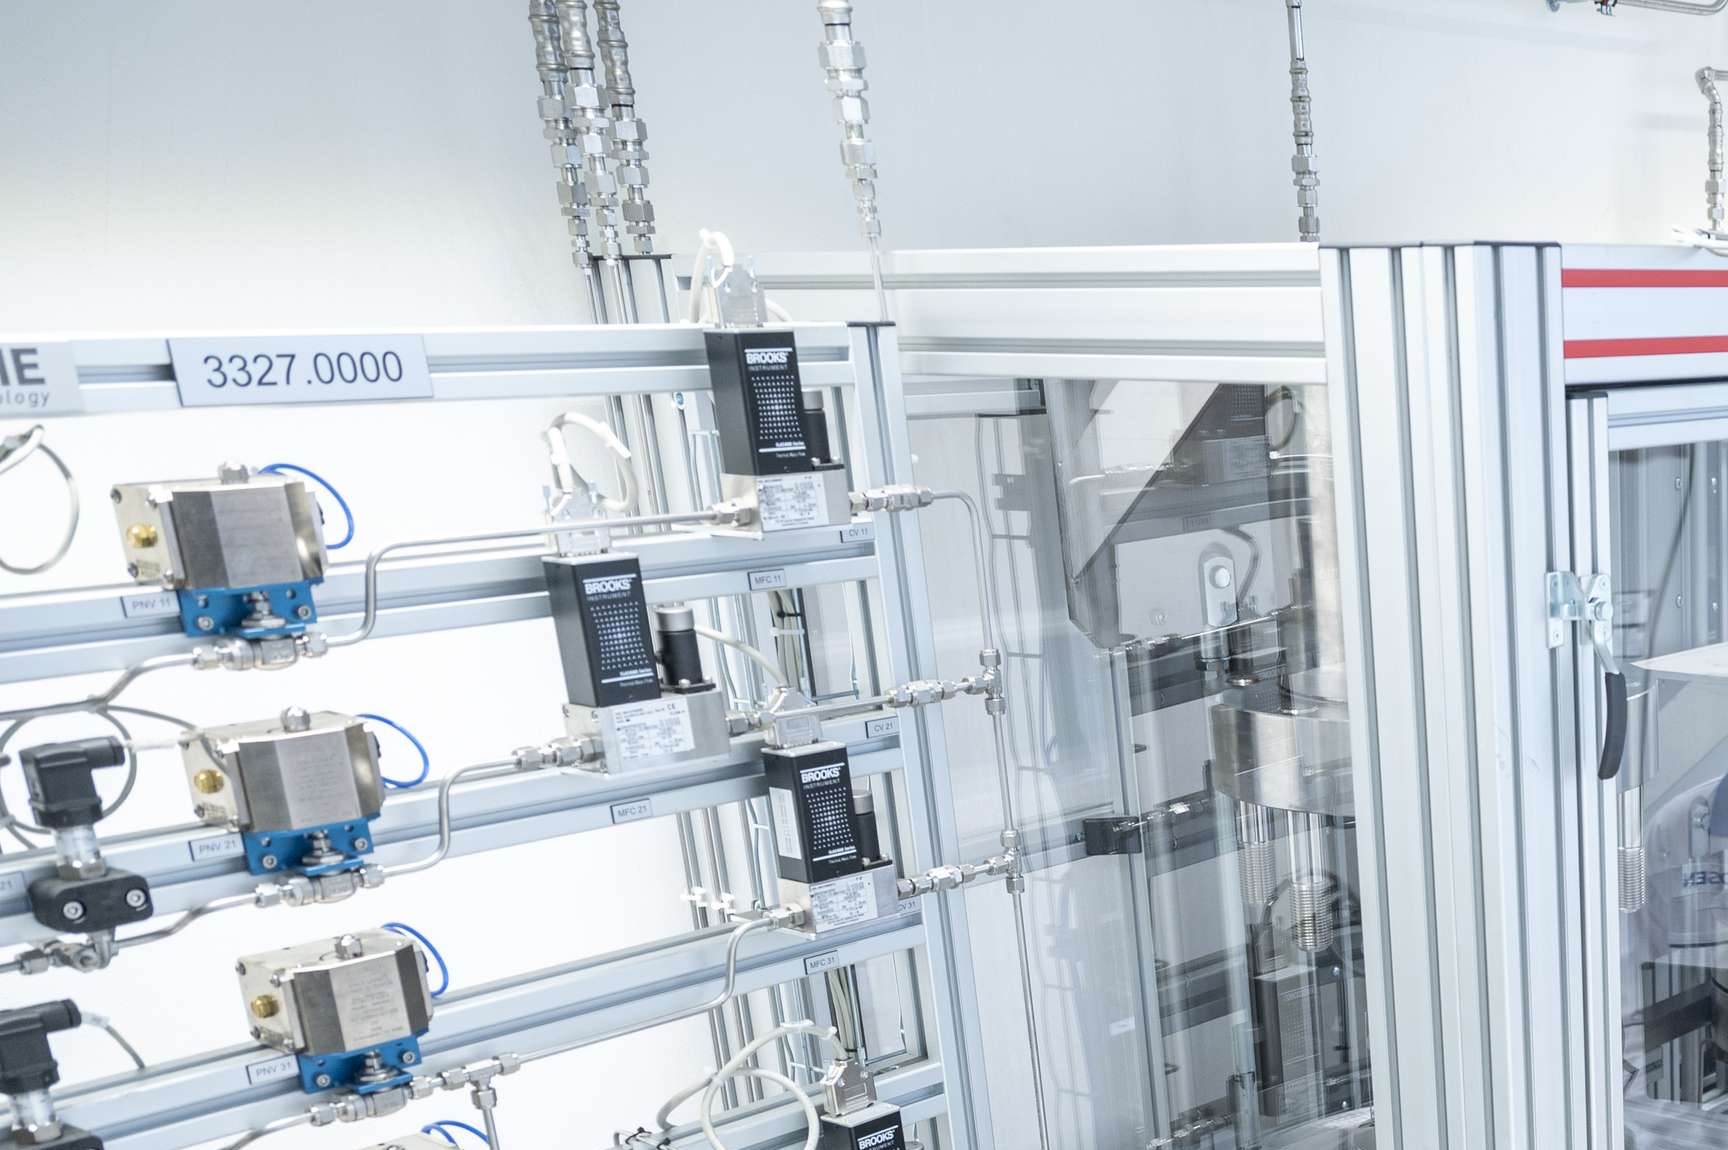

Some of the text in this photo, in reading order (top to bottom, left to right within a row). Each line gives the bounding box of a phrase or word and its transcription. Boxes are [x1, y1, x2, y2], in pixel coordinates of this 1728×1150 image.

[746, 352, 787, 364] BROOKS
[203, 351, 403, 388] 3327.0000
[584, 579, 631, 594] BROOKS
[802, 768, 841, 783] BROOKS
[859, 1131, 895, 1149] BROOKS
